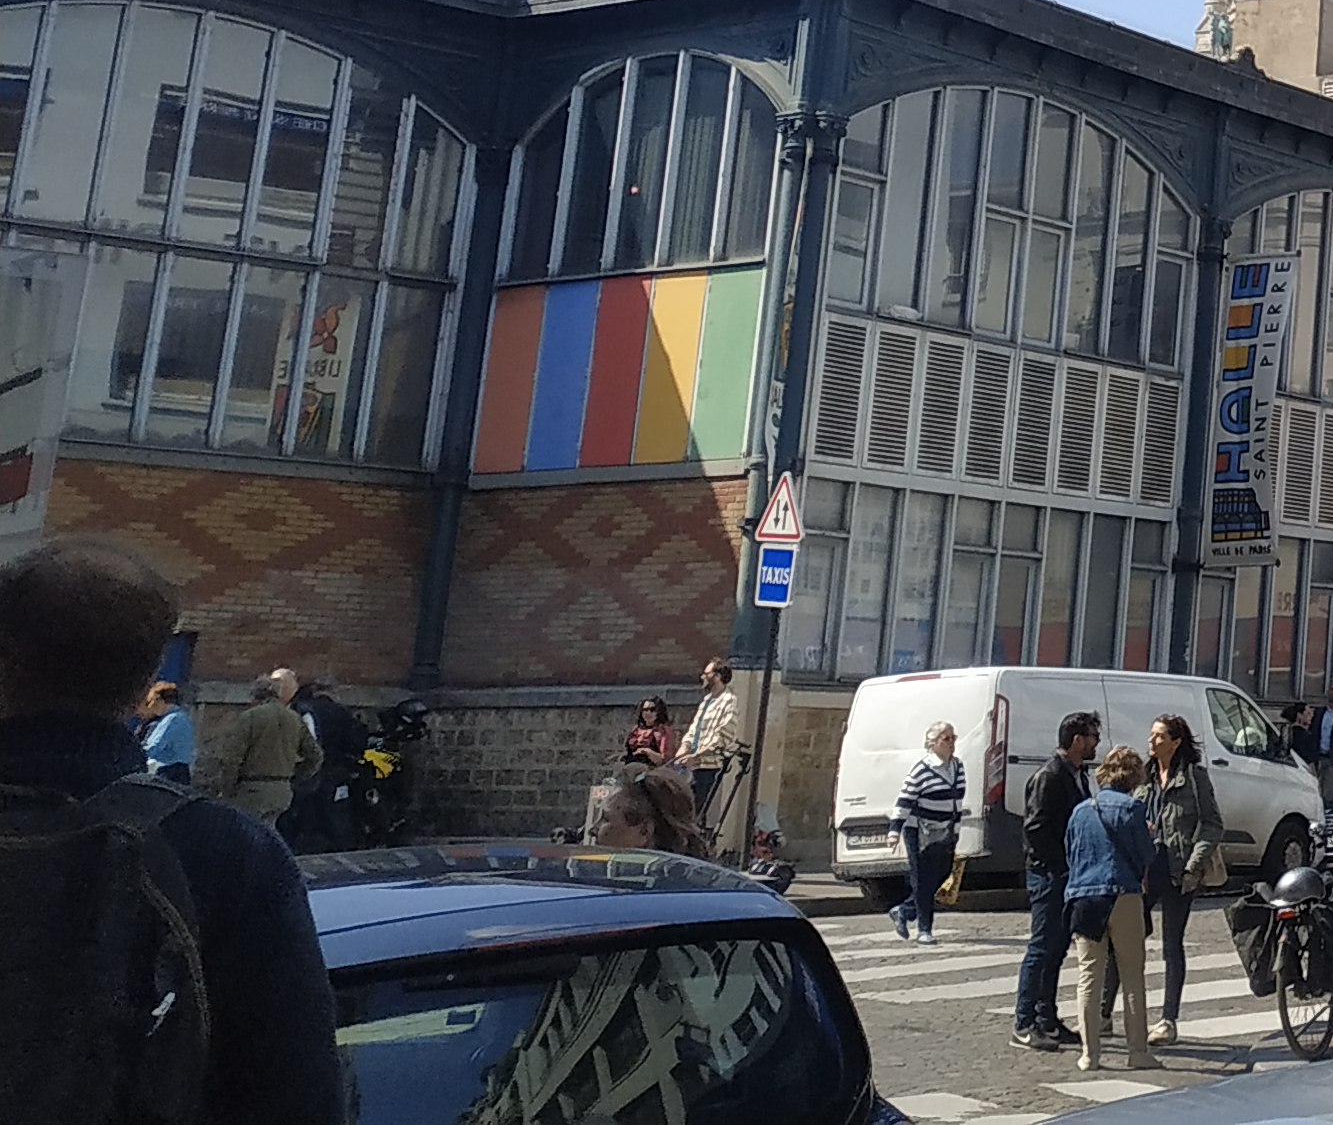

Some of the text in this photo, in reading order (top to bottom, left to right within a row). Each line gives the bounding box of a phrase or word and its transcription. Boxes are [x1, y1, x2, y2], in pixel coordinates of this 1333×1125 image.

[1214, 262, 1271, 484] HALLE
[1253, 261, 1292, 480] SAINT PIERRE
[762, 565, 790, 585] TAXIS
[1212, 545, 1272, 557] VILLE DE PARIS
